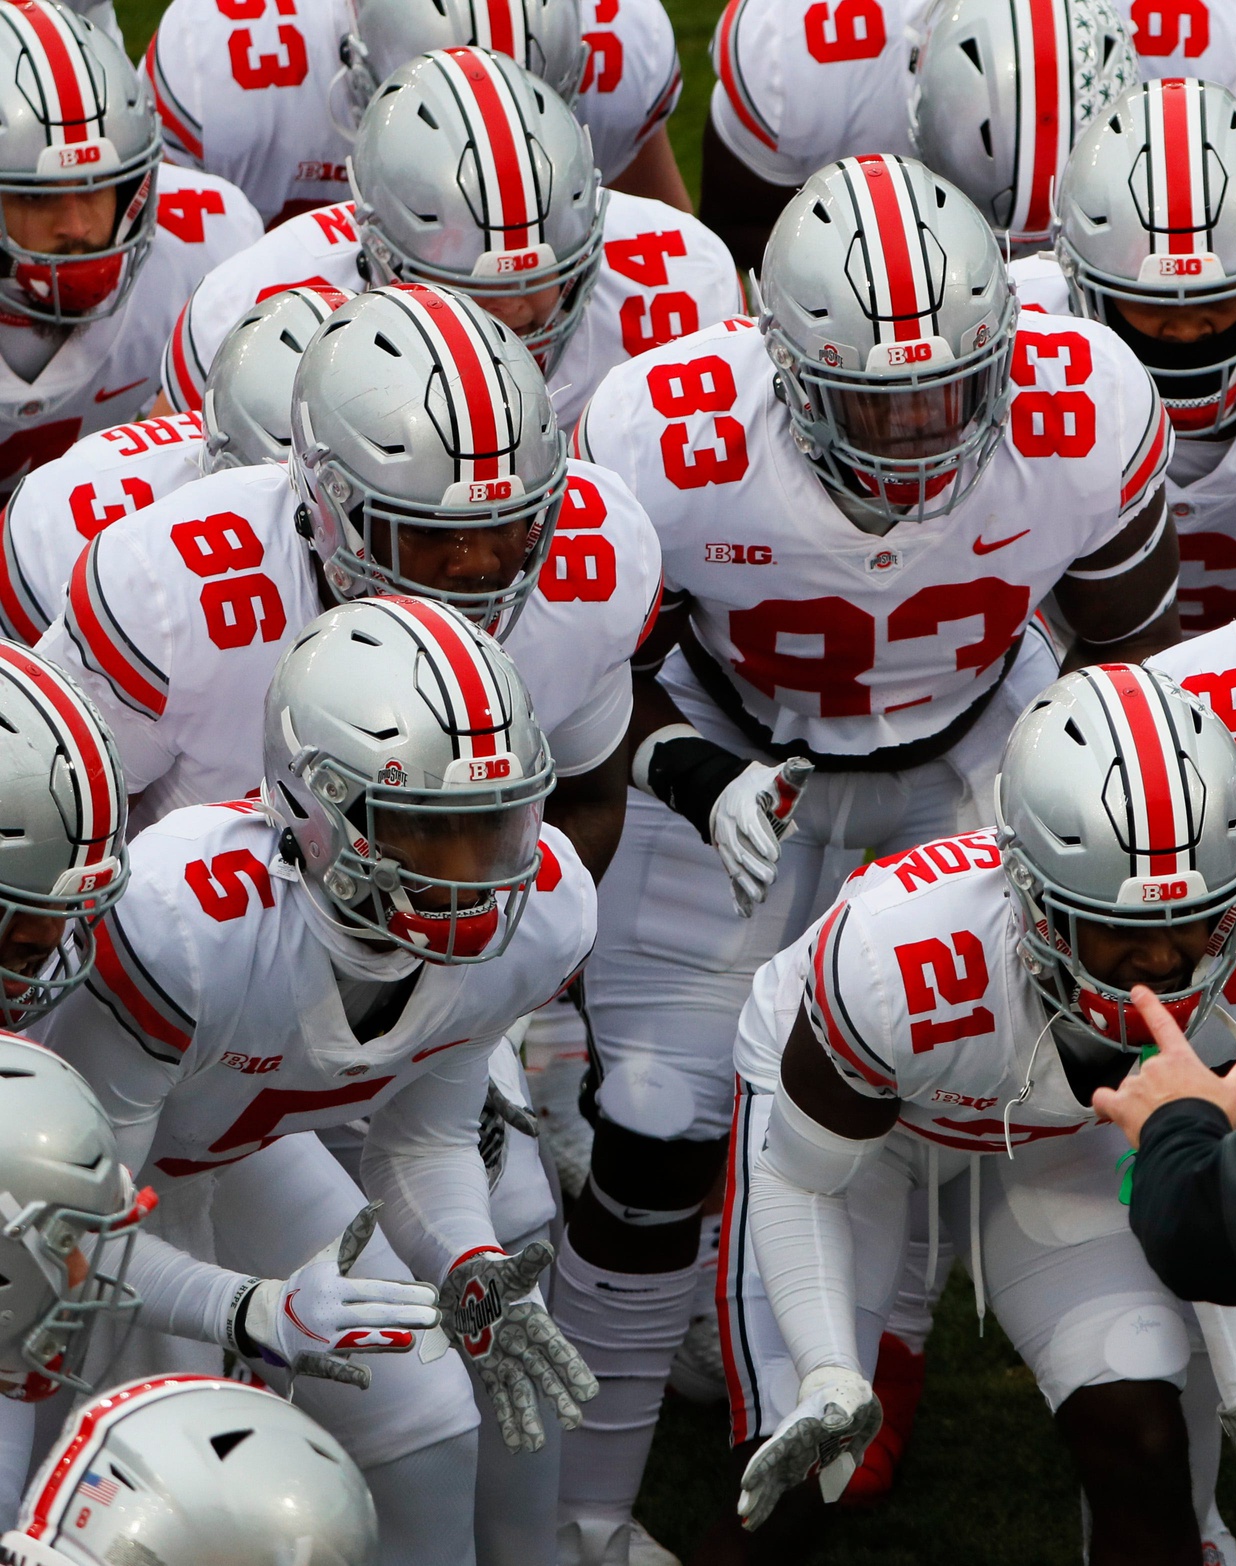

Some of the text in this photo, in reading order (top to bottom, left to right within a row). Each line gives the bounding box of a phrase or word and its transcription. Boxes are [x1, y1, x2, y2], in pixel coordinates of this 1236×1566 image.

[602, 230, 699, 357] 64
[646, 355, 750, 490] 83
[1009, 331, 1096, 458] 83
[170, 511, 287, 650] 86
[184, 848, 275, 922] 5
[894, 929, 995, 1054] 21
